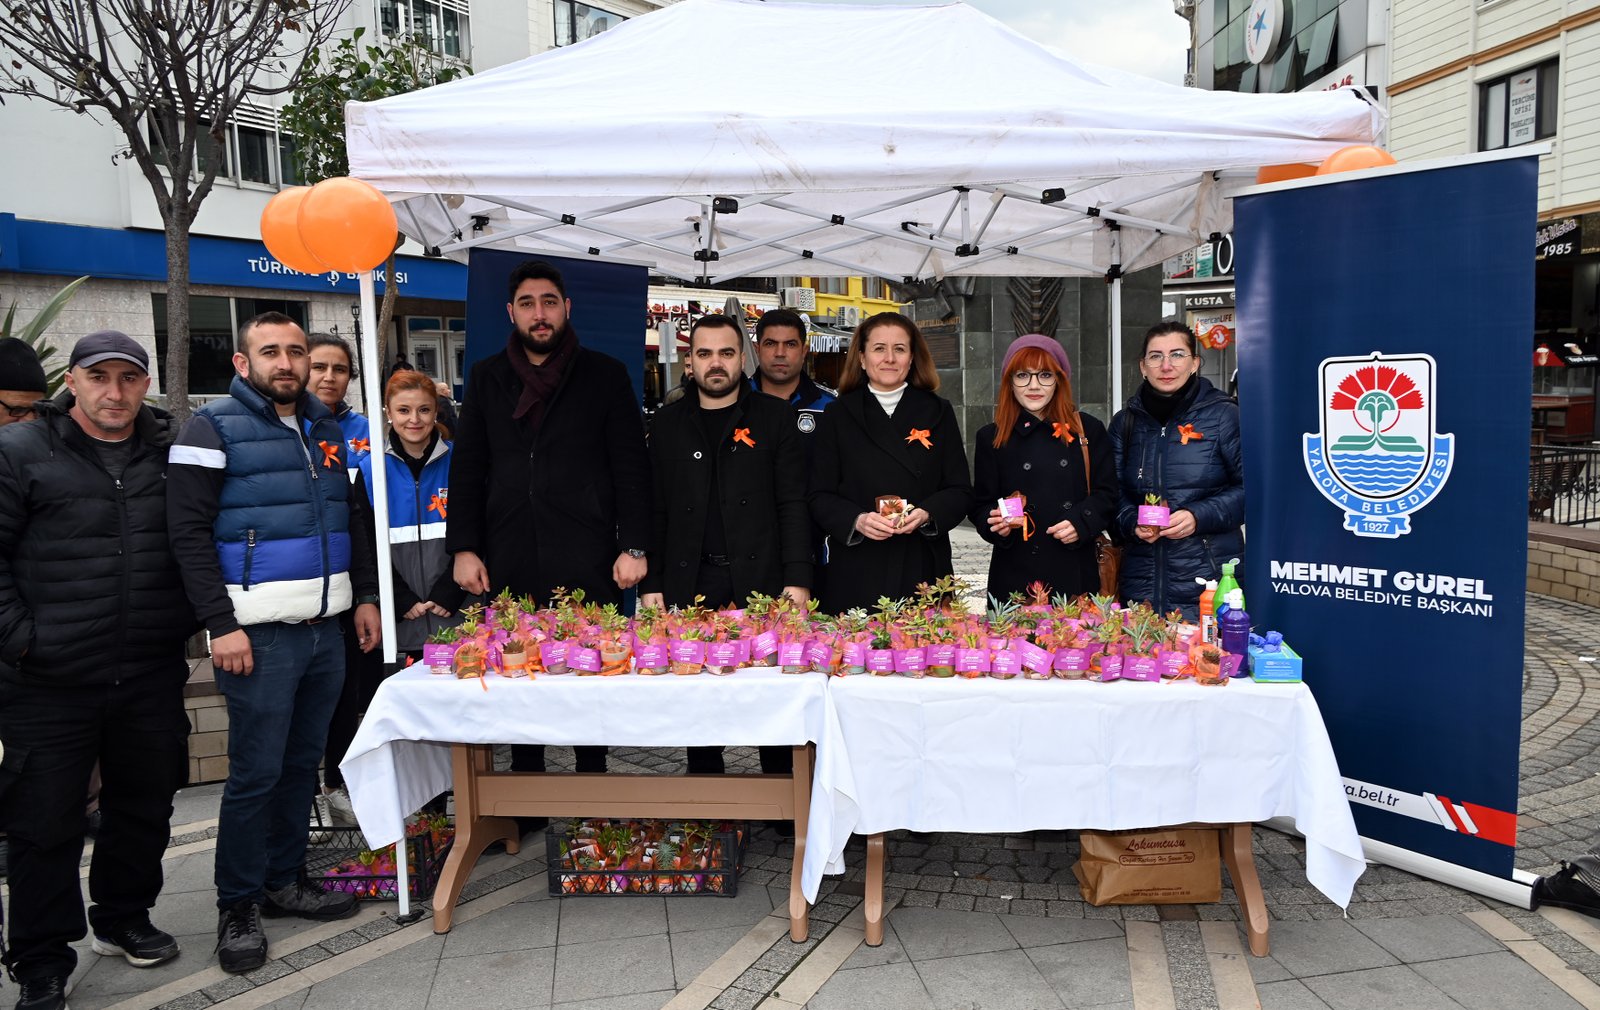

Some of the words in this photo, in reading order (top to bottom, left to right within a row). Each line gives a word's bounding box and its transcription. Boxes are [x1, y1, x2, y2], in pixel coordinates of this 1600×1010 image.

[1543, 242, 1572, 256] 1985
[1194, 296, 1224, 306] USTA
[1309, 447, 1349, 503] YALOVA
[1363, 522, 1389, 532] 1927
[1270, 560, 1388, 588] MEHMET
[1271, 582, 1332, 598] YALOVA
[1417, 596, 1493, 618] BAŞKANI
[1343, 784, 1400, 806] a.bel.tr
